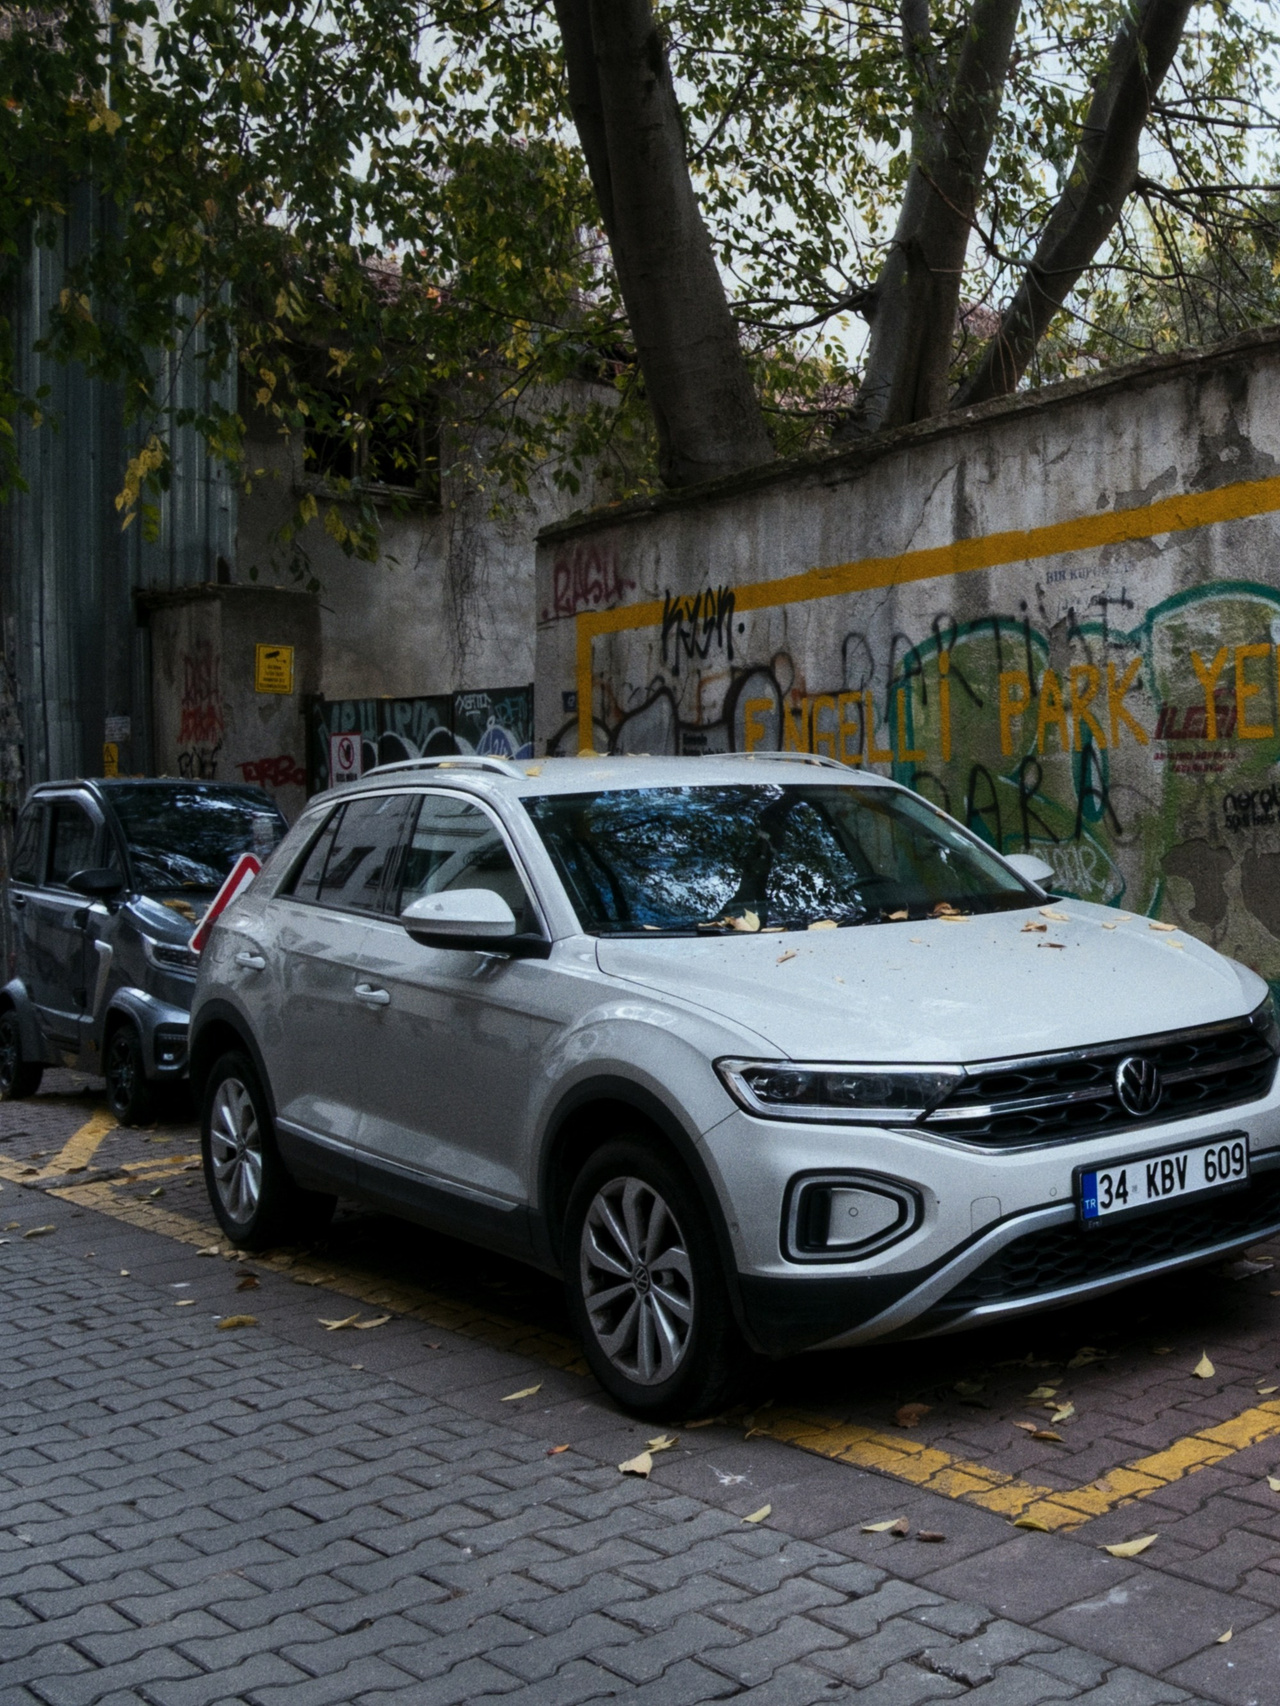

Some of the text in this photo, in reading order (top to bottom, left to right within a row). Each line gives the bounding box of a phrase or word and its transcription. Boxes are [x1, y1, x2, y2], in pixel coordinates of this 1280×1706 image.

[999, 656, 1149, 756] PARK
[1084, 1142, 1244, 1210] TR 34 KBV 609
